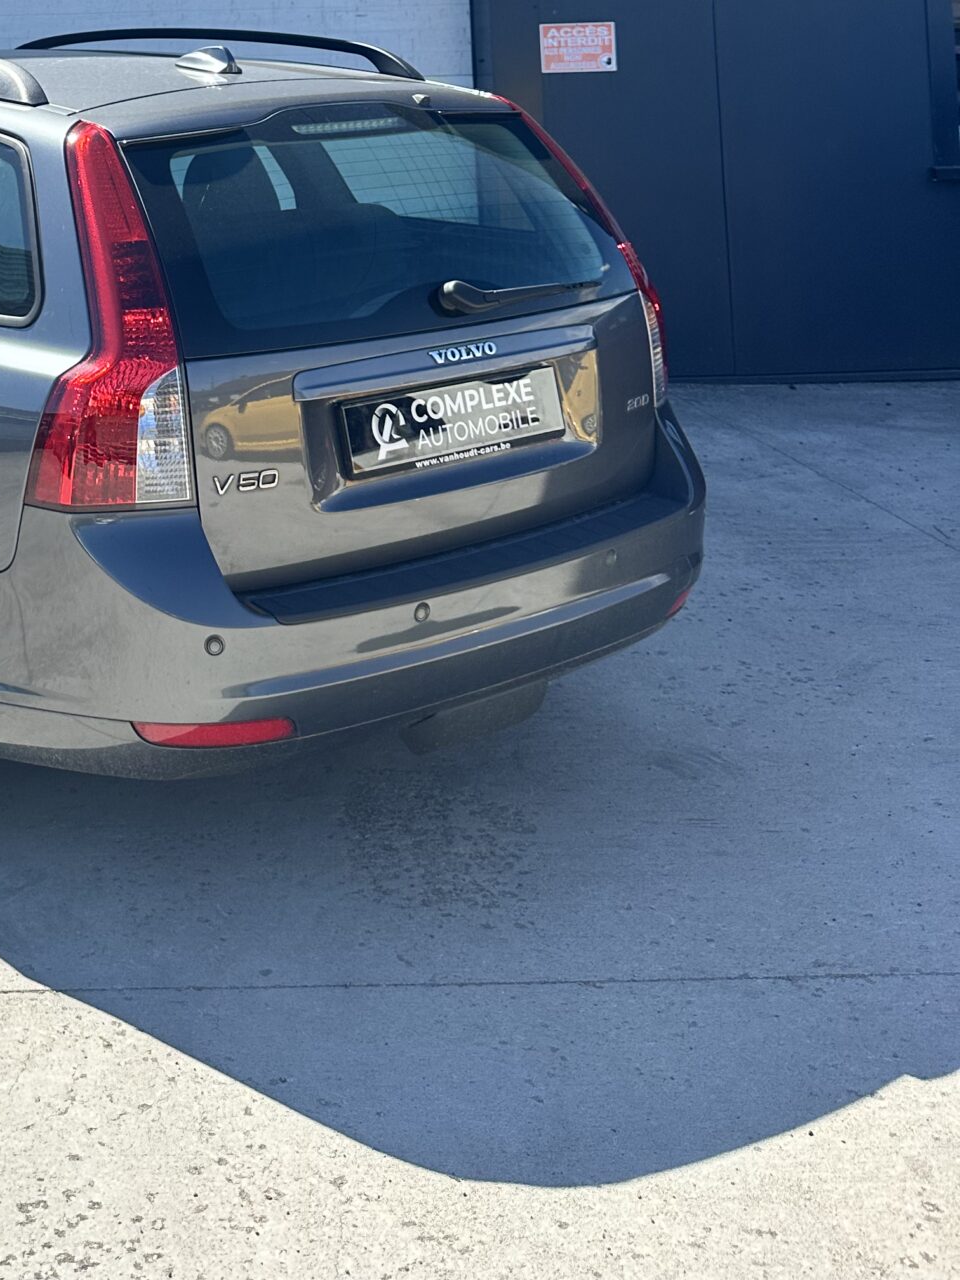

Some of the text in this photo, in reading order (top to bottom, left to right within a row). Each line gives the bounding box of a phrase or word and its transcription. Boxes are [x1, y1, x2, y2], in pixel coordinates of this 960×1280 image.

[544, 35, 611, 47] INTERDIT
[429, 341, 497, 365] VOLVO
[411, 377, 535, 423] COMPLEXE
[417, 406, 540, 451] AUTOMOBILE
[415, 441, 511, 469] www.vanhoudt-cars.be
[212, 468, 280, 496] V50
